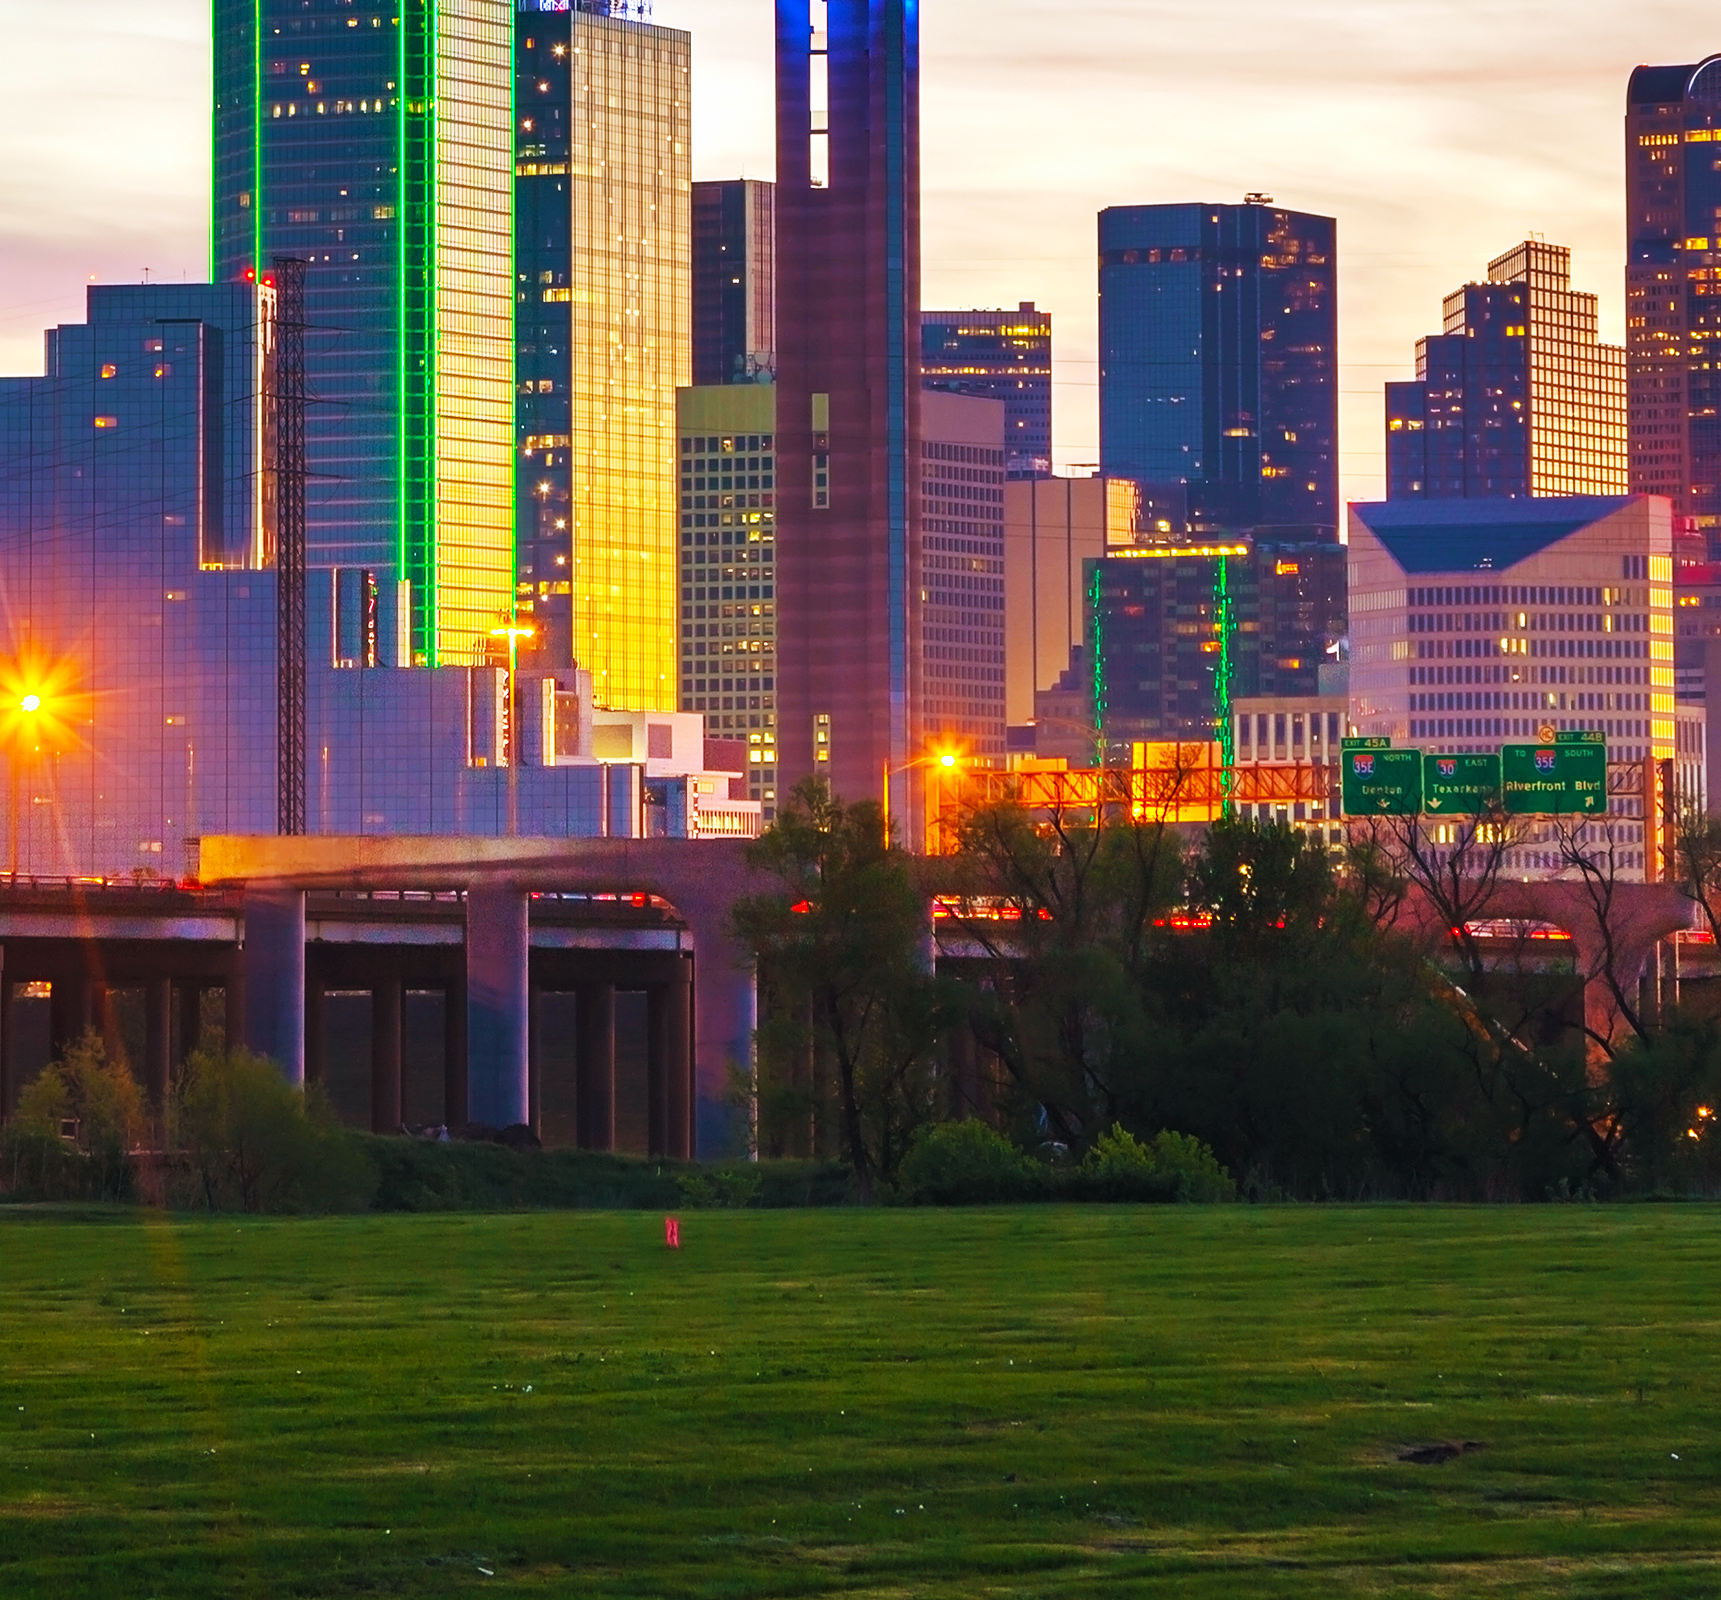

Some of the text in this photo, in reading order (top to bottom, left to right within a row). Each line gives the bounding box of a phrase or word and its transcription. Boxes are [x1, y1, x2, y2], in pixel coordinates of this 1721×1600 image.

[1558, 732, 1603, 741] EXIT 44B
[1344, 738, 1387, 747] EXIT 45A
[1353, 754, 1412, 773] 35E NORTH
[1514, 749, 1594, 769] TO 35E SOUTH
[1439, 759, 1487, 775] 30 EAST
[1361, 785, 1403, 795] Denton
[1505, 780, 1601, 791] Riverfront Blvd
